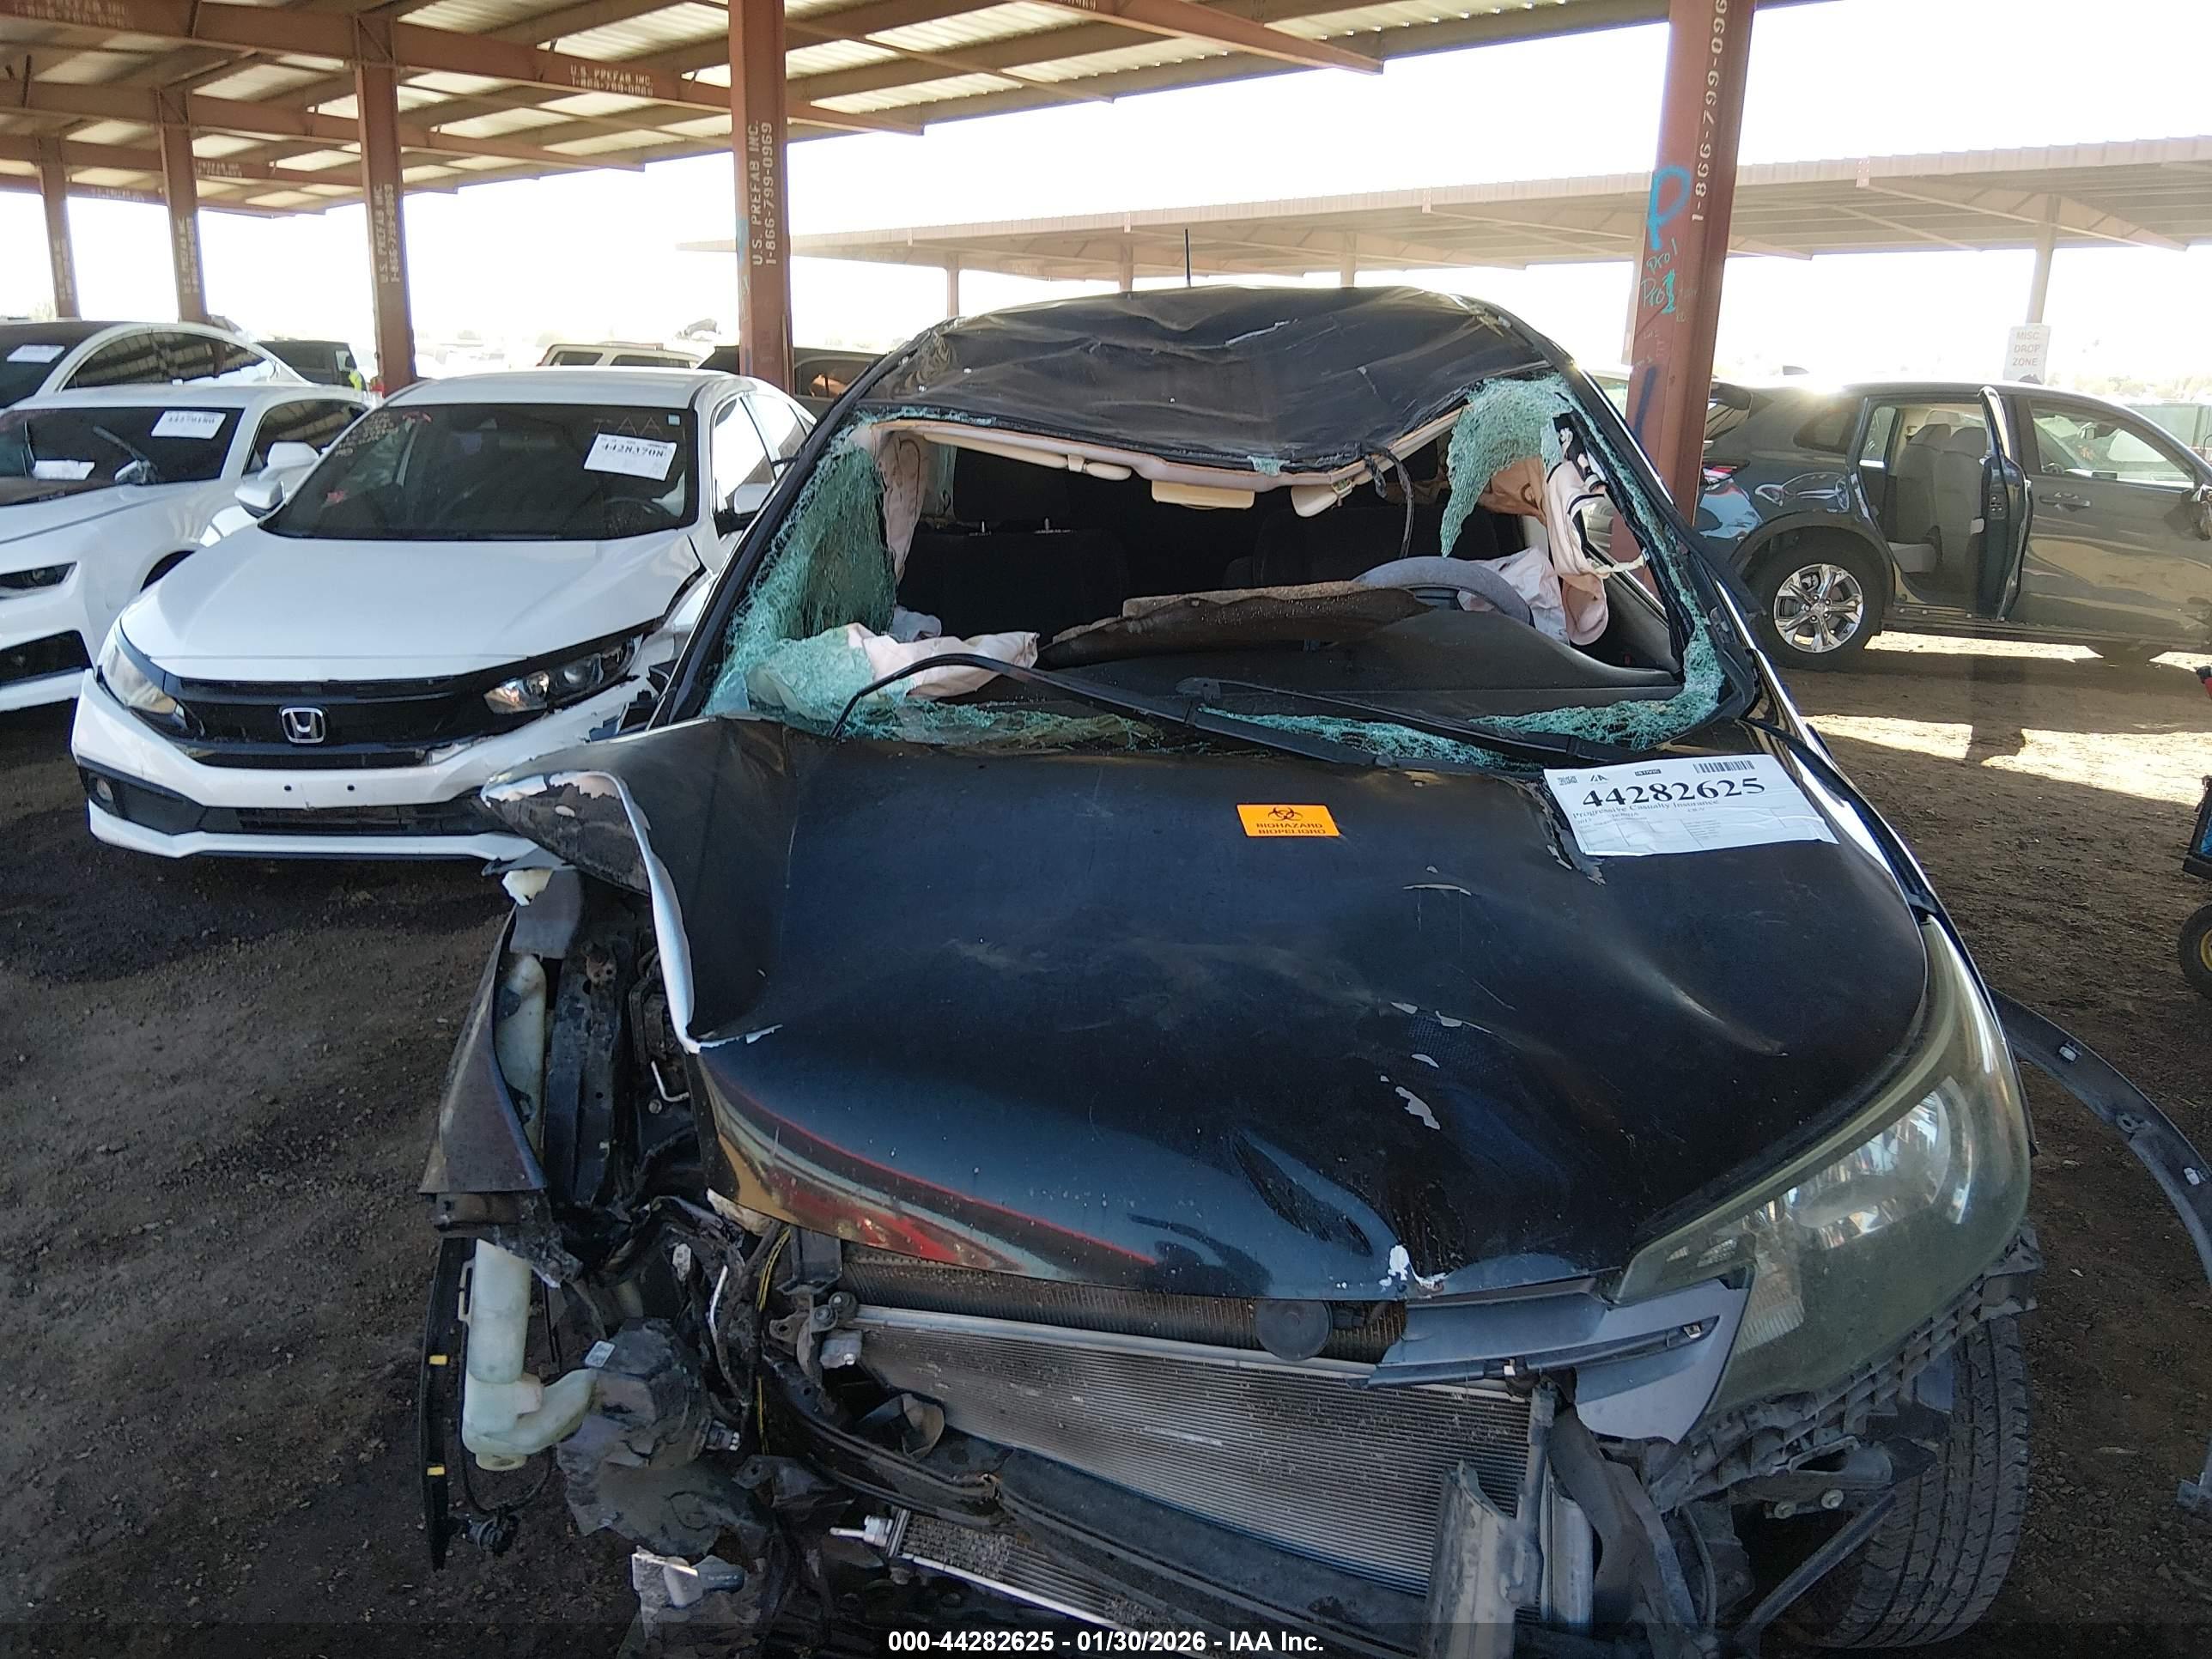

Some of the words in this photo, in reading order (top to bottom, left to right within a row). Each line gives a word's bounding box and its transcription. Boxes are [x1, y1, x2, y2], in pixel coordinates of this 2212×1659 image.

[748, 119, 759, 152] INC.
[749, 160, 762, 226] PREFAB
[761, 122, 776, 264] 1-866-799-0969
[751, 234, 763, 265] U.S.
[2014, 344, 2041, 353] DROP
[2015, 331, 2040, 340] MISC
[2012, 357, 2039, 366] ZONE
[1583, 778, 1765, 806] 44282625
[1572, 807, 1627, 818] Progressive
[1629, 802, 1670, 811] Casualty
[1673, 799, 1719, 808] Insurance
